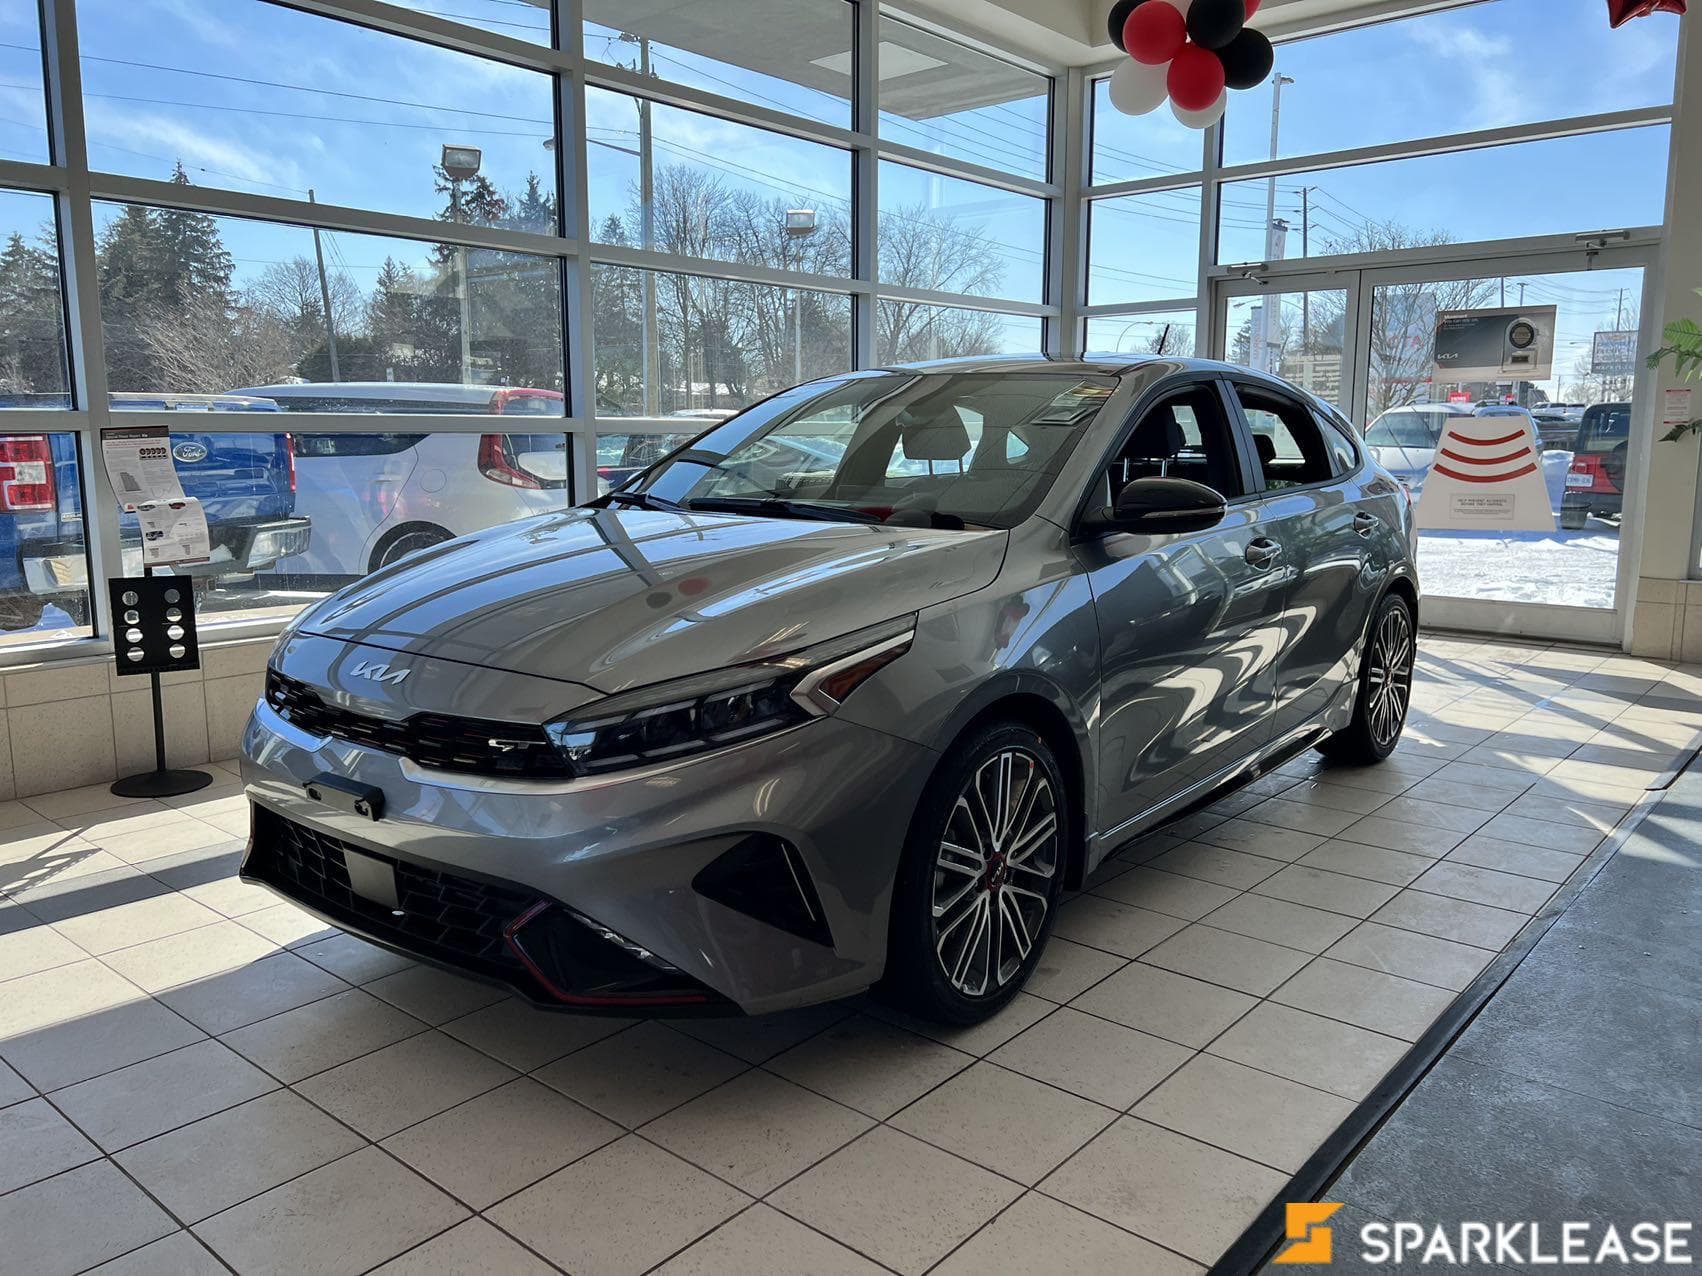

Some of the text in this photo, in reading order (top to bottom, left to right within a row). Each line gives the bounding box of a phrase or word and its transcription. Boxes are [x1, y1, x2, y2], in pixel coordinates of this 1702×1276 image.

[1438, 352, 1458, 360] KIA
[181, 445, 204, 458] Ford
[350, 660, 411, 685] KIA
